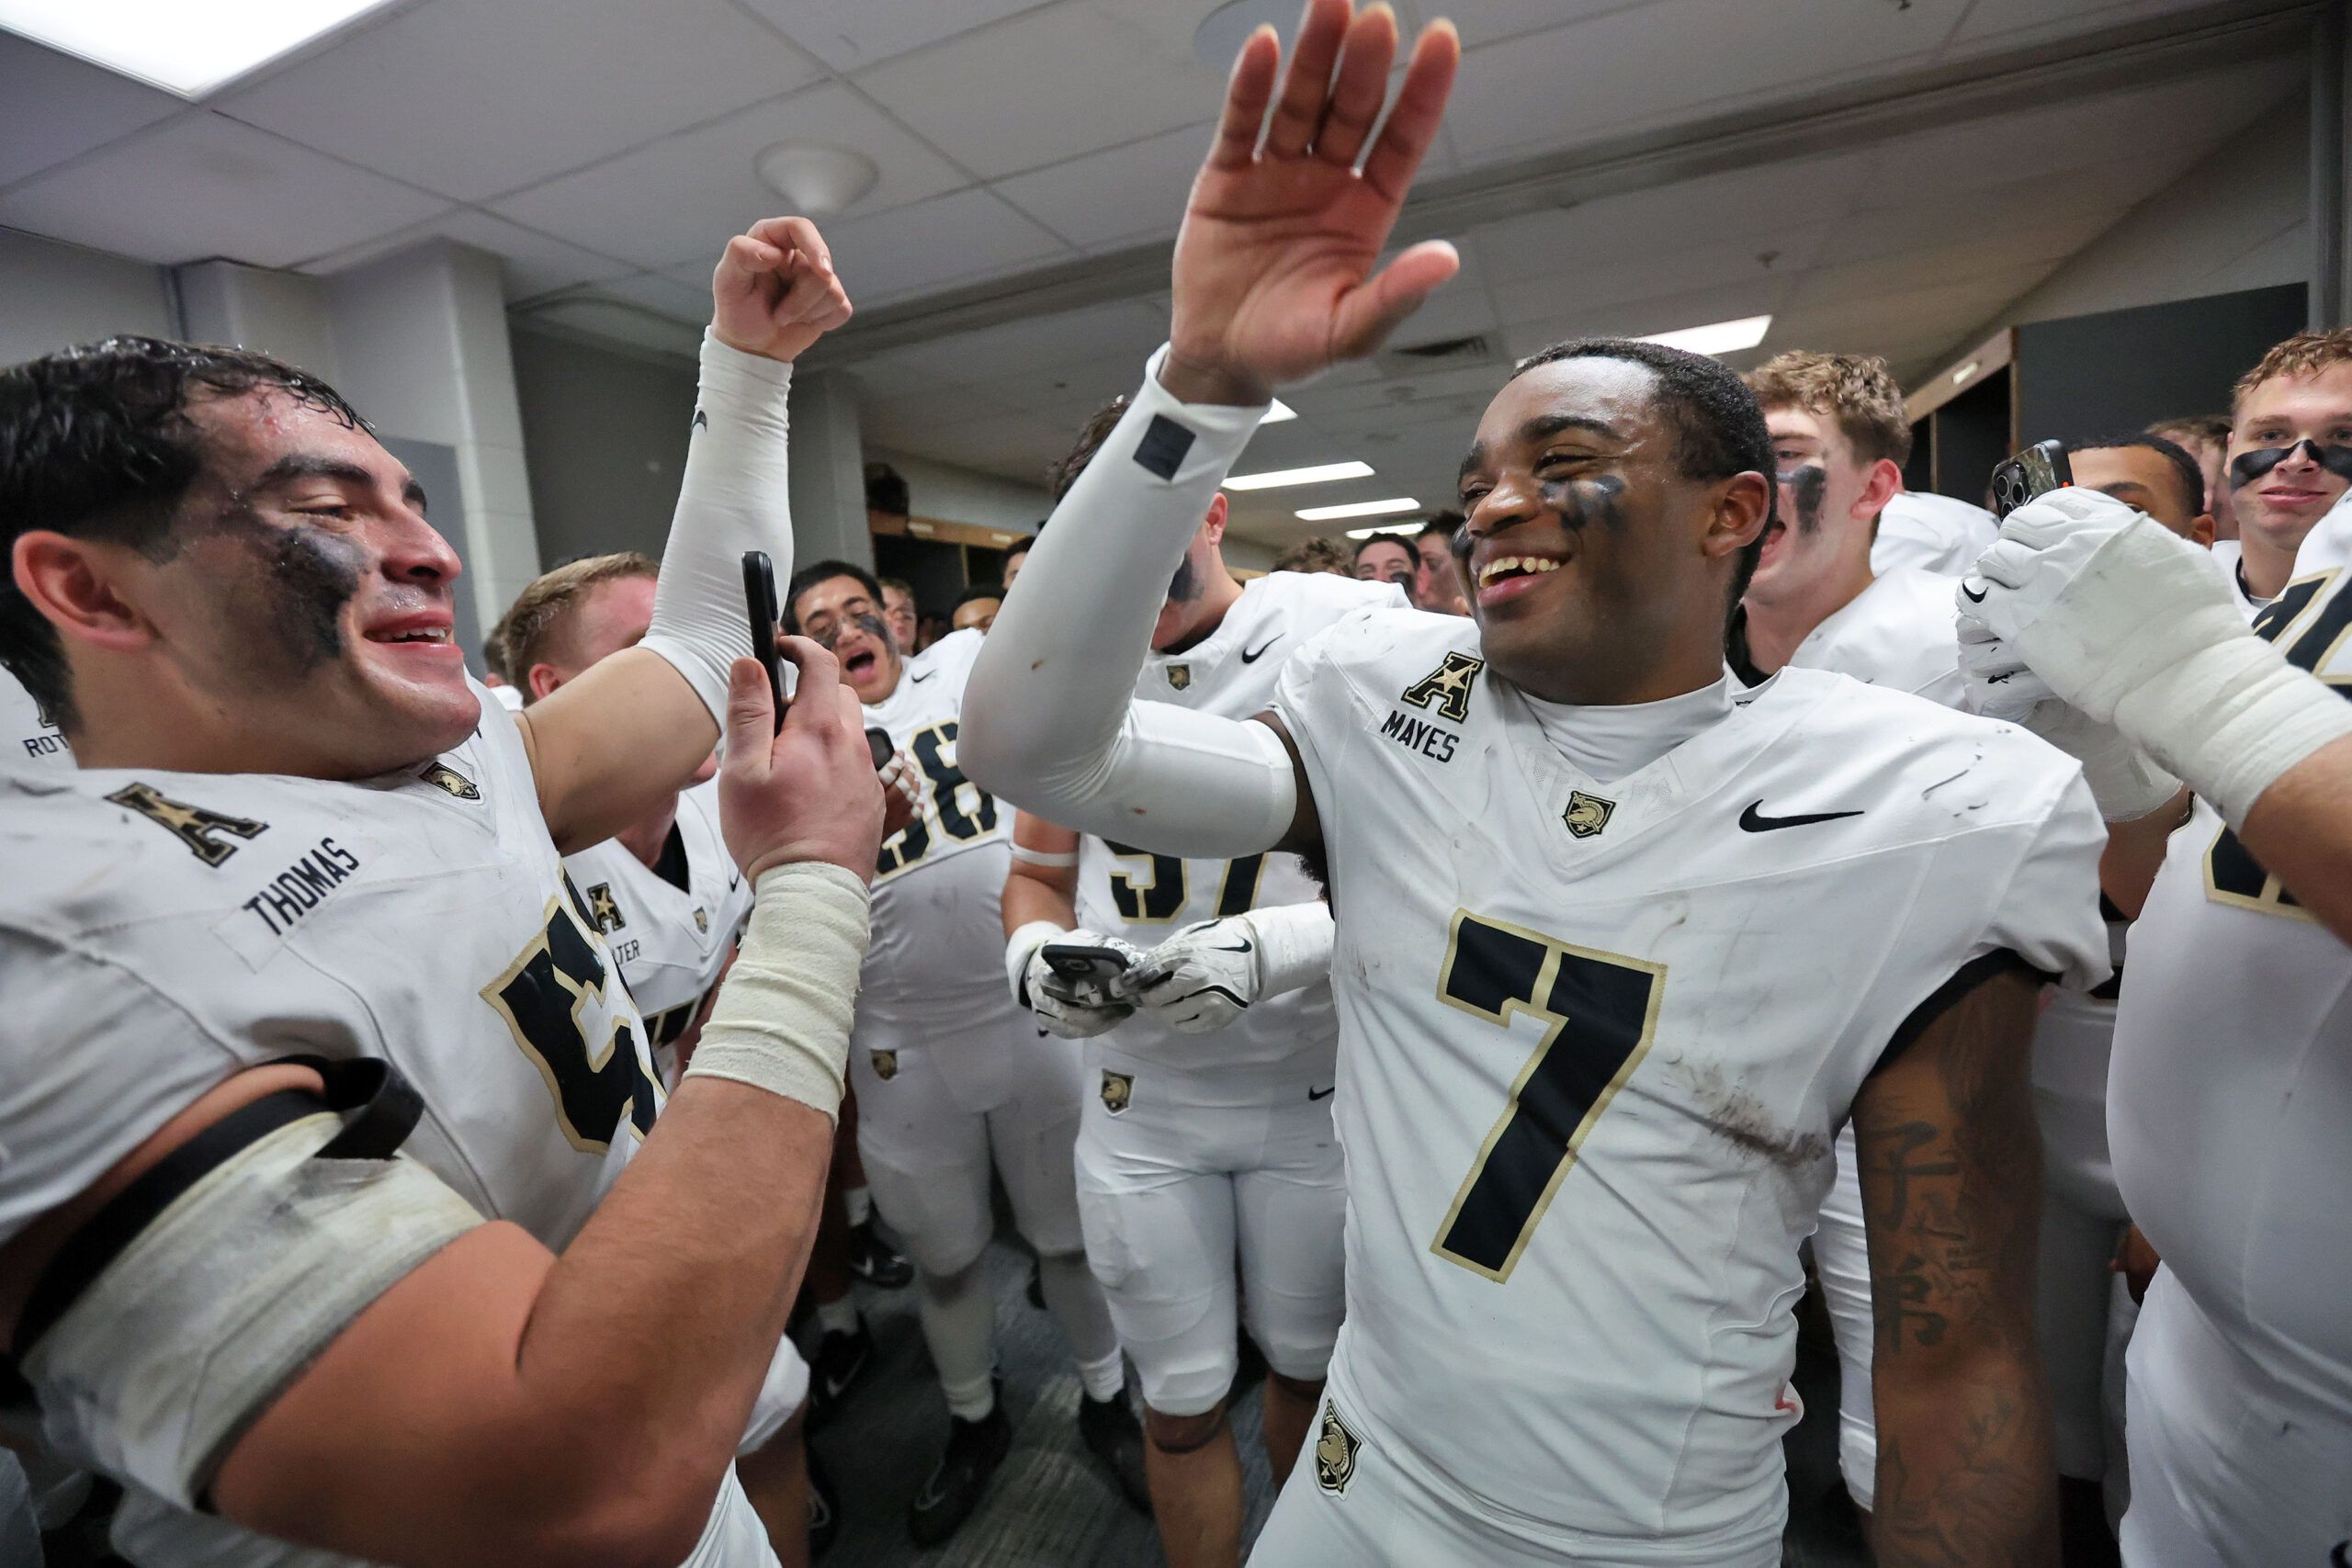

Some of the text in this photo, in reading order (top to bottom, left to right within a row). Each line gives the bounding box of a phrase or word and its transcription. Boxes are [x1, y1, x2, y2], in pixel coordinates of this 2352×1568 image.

[1380, 709, 1460, 763] MAYES
[243, 837, 359, 935] THOMAS
[1430, 907, 1668, 1285] 7
